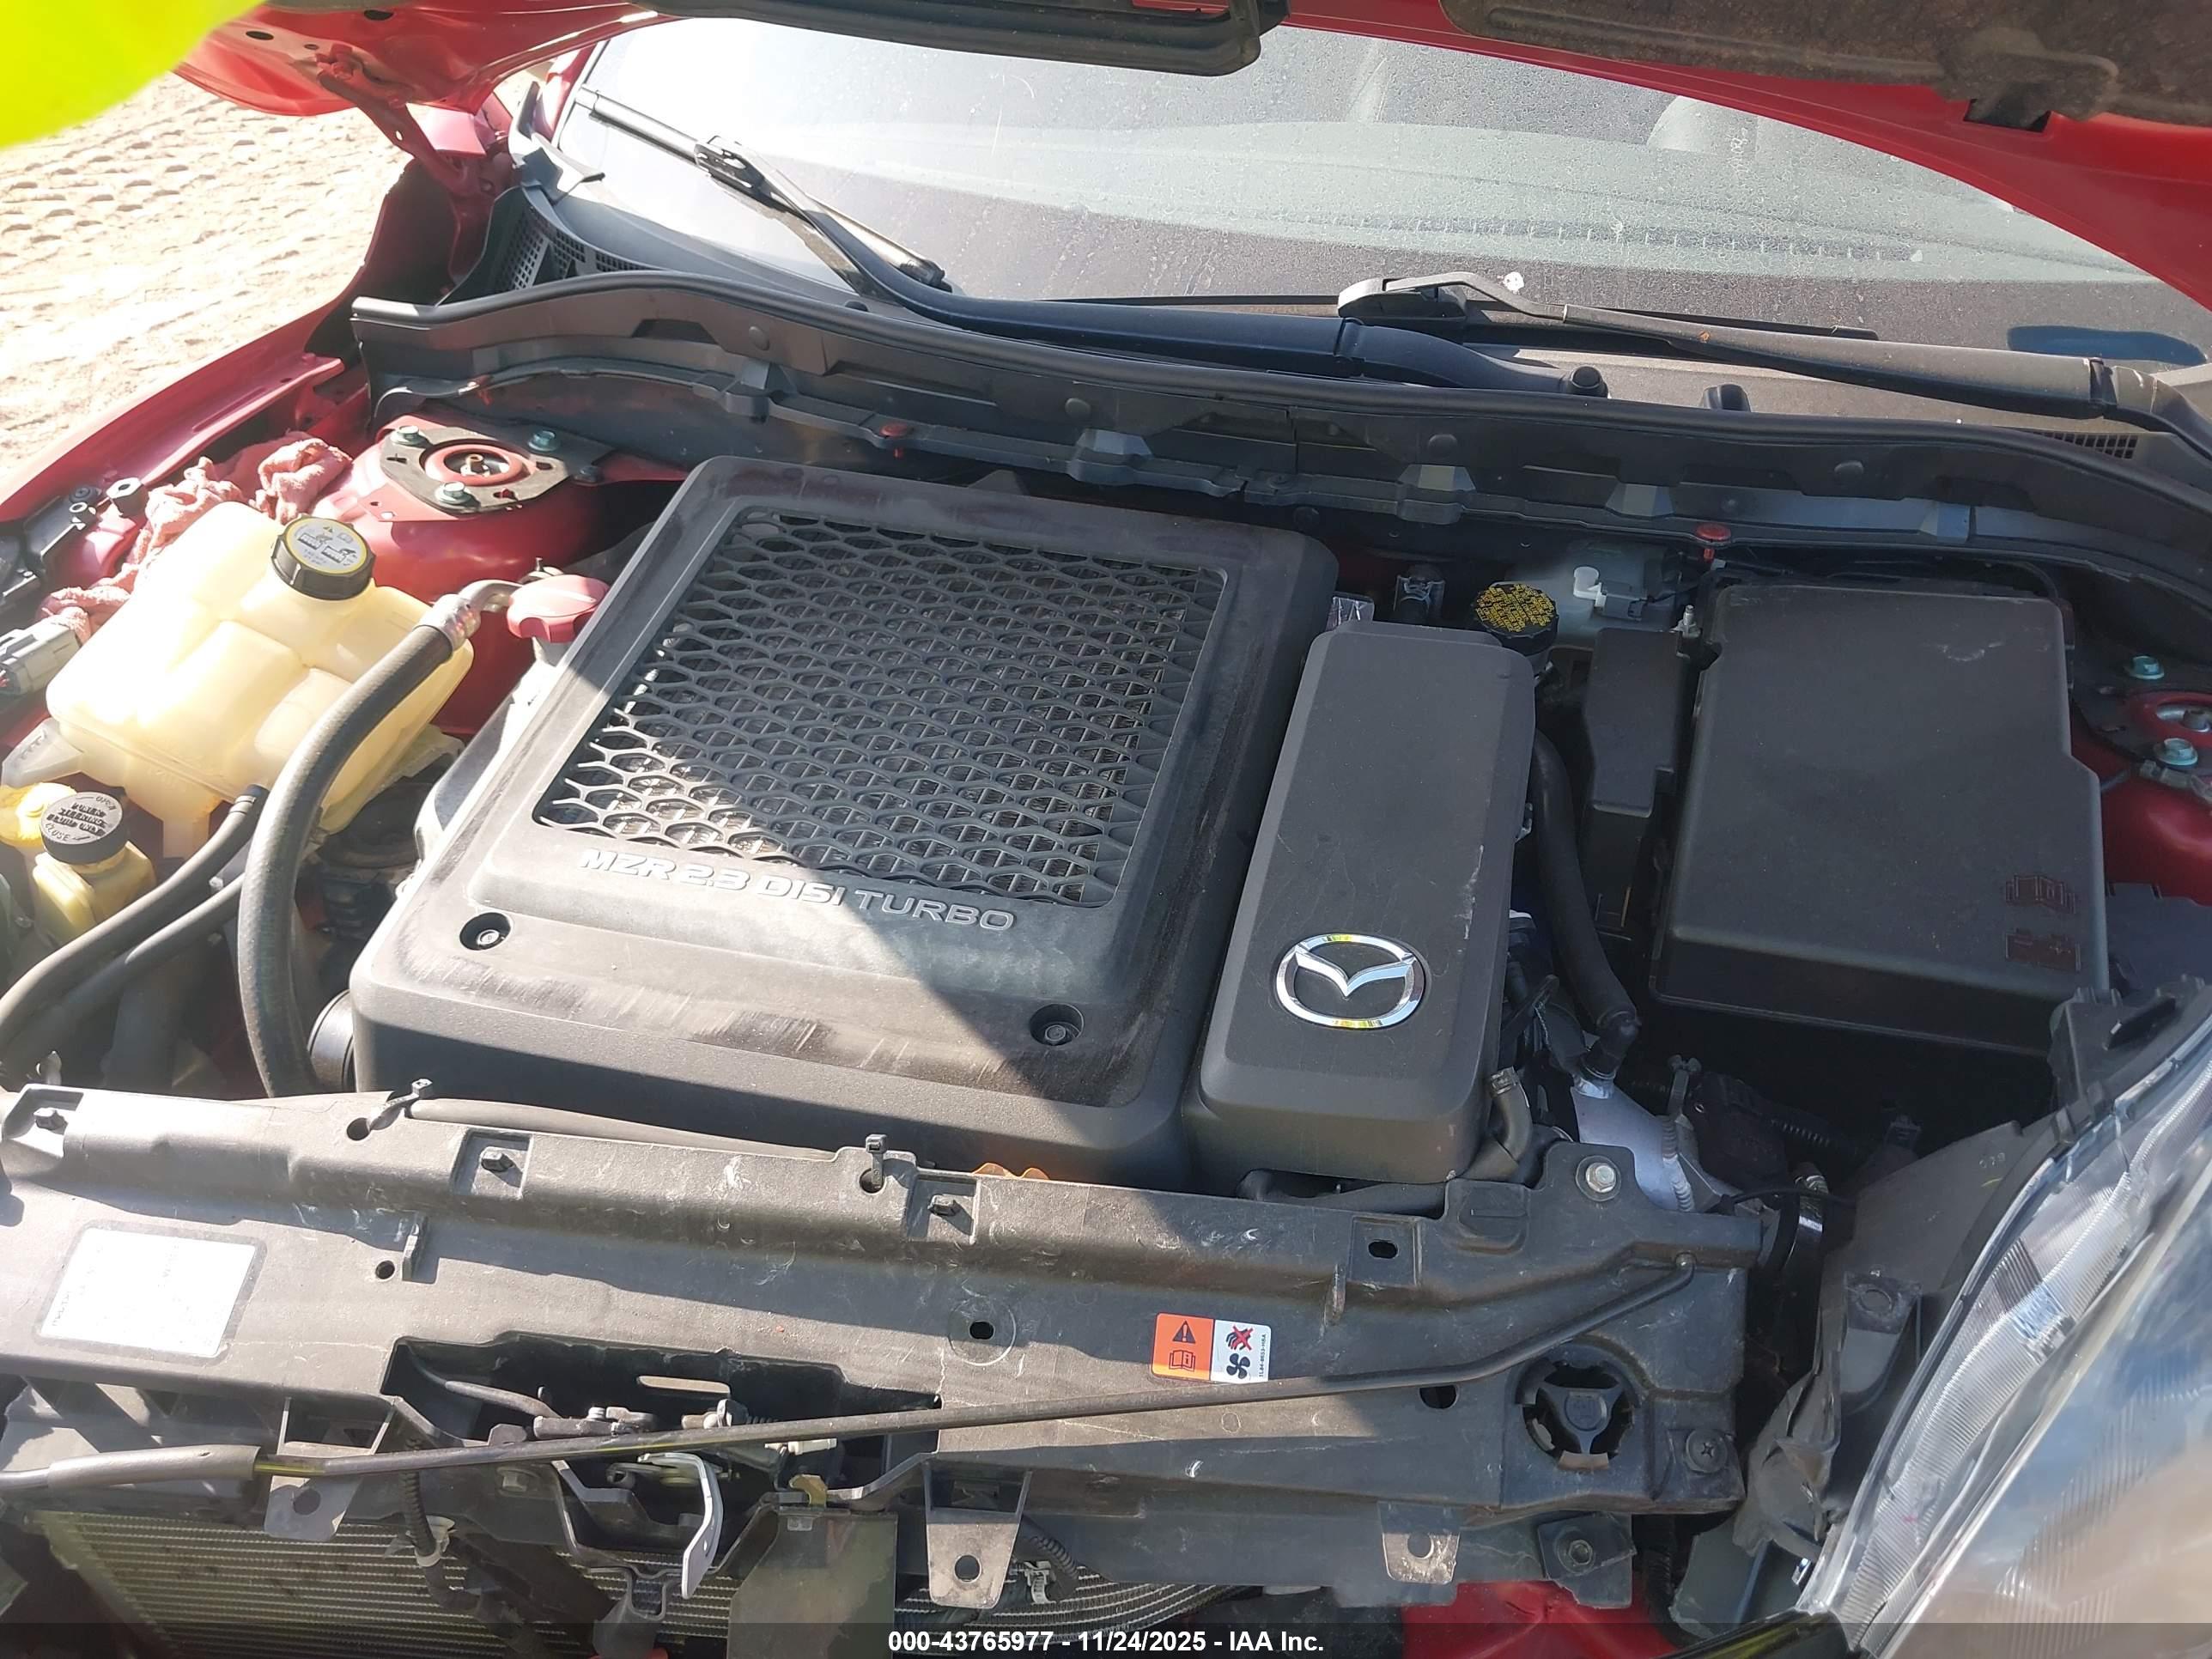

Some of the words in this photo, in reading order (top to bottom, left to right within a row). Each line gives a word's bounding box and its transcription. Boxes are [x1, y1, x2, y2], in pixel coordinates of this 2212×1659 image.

[580, 848, 677, 881] MZR
[678, 863, 750, 891] 2.3
[755, 874, 846, 906] DISI
[854, 888, 1017, 932] TURBO
